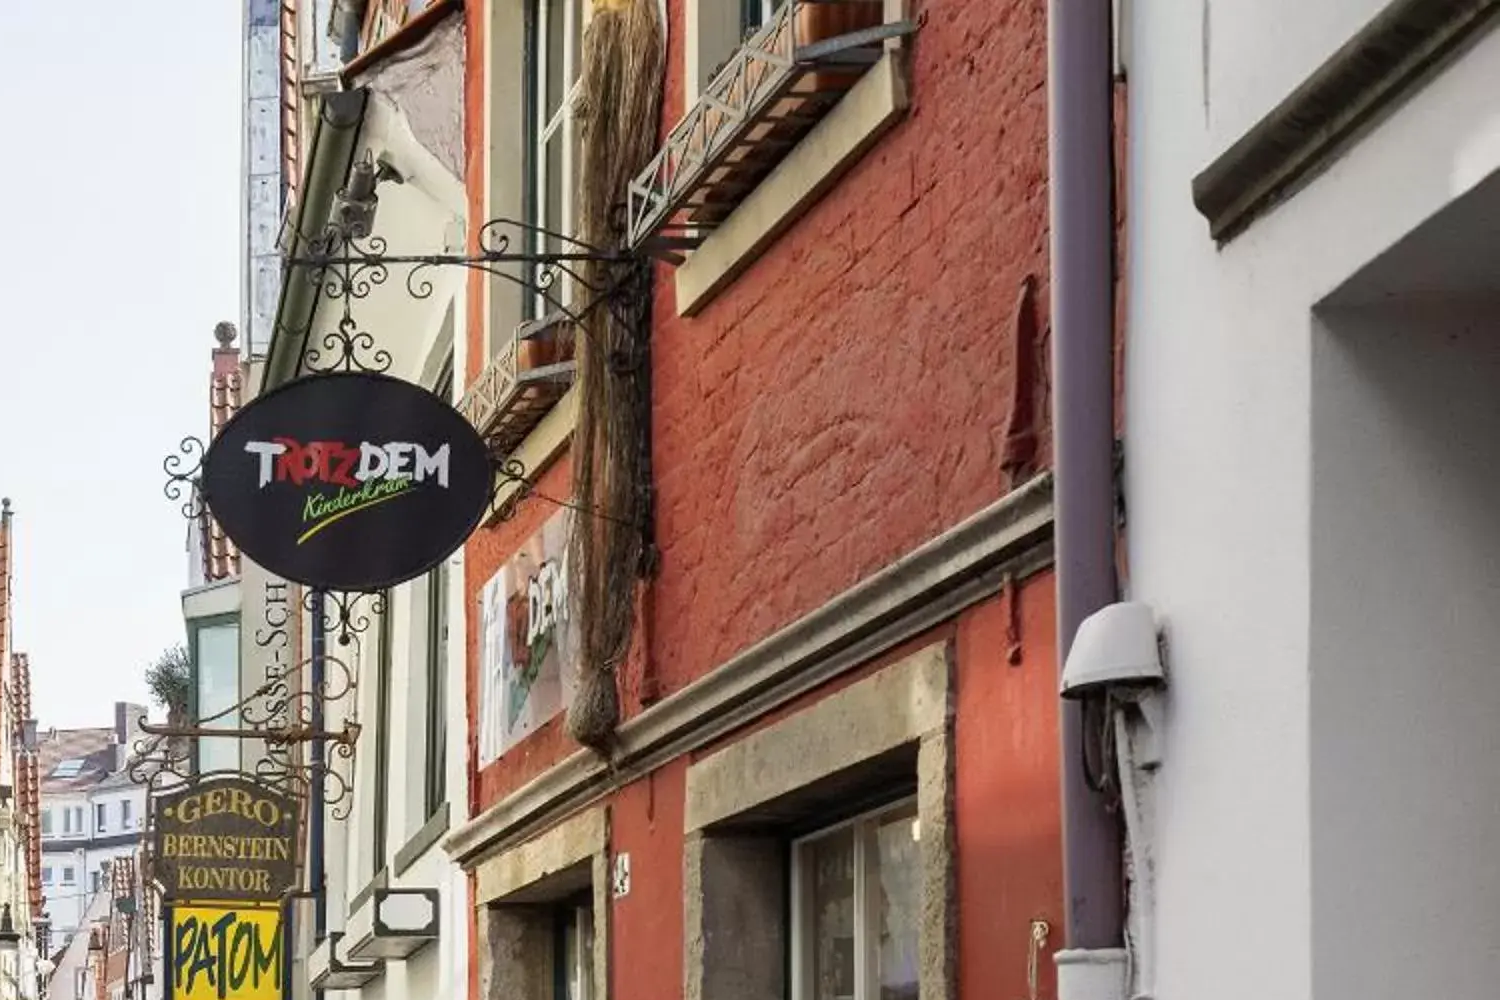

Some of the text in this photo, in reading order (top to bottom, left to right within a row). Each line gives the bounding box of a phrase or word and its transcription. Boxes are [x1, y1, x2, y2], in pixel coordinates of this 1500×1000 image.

[244, 436, 450, 489] TROTZDEM
[301, 478, 412, 522] Kinderkram
[177, 788, 280, 826] GERO
[162, 834, 290, 861] BERNSTEIN
[177, 866, 271, 891] KONTOR
[174, 912, 283, 1000] PATOM
